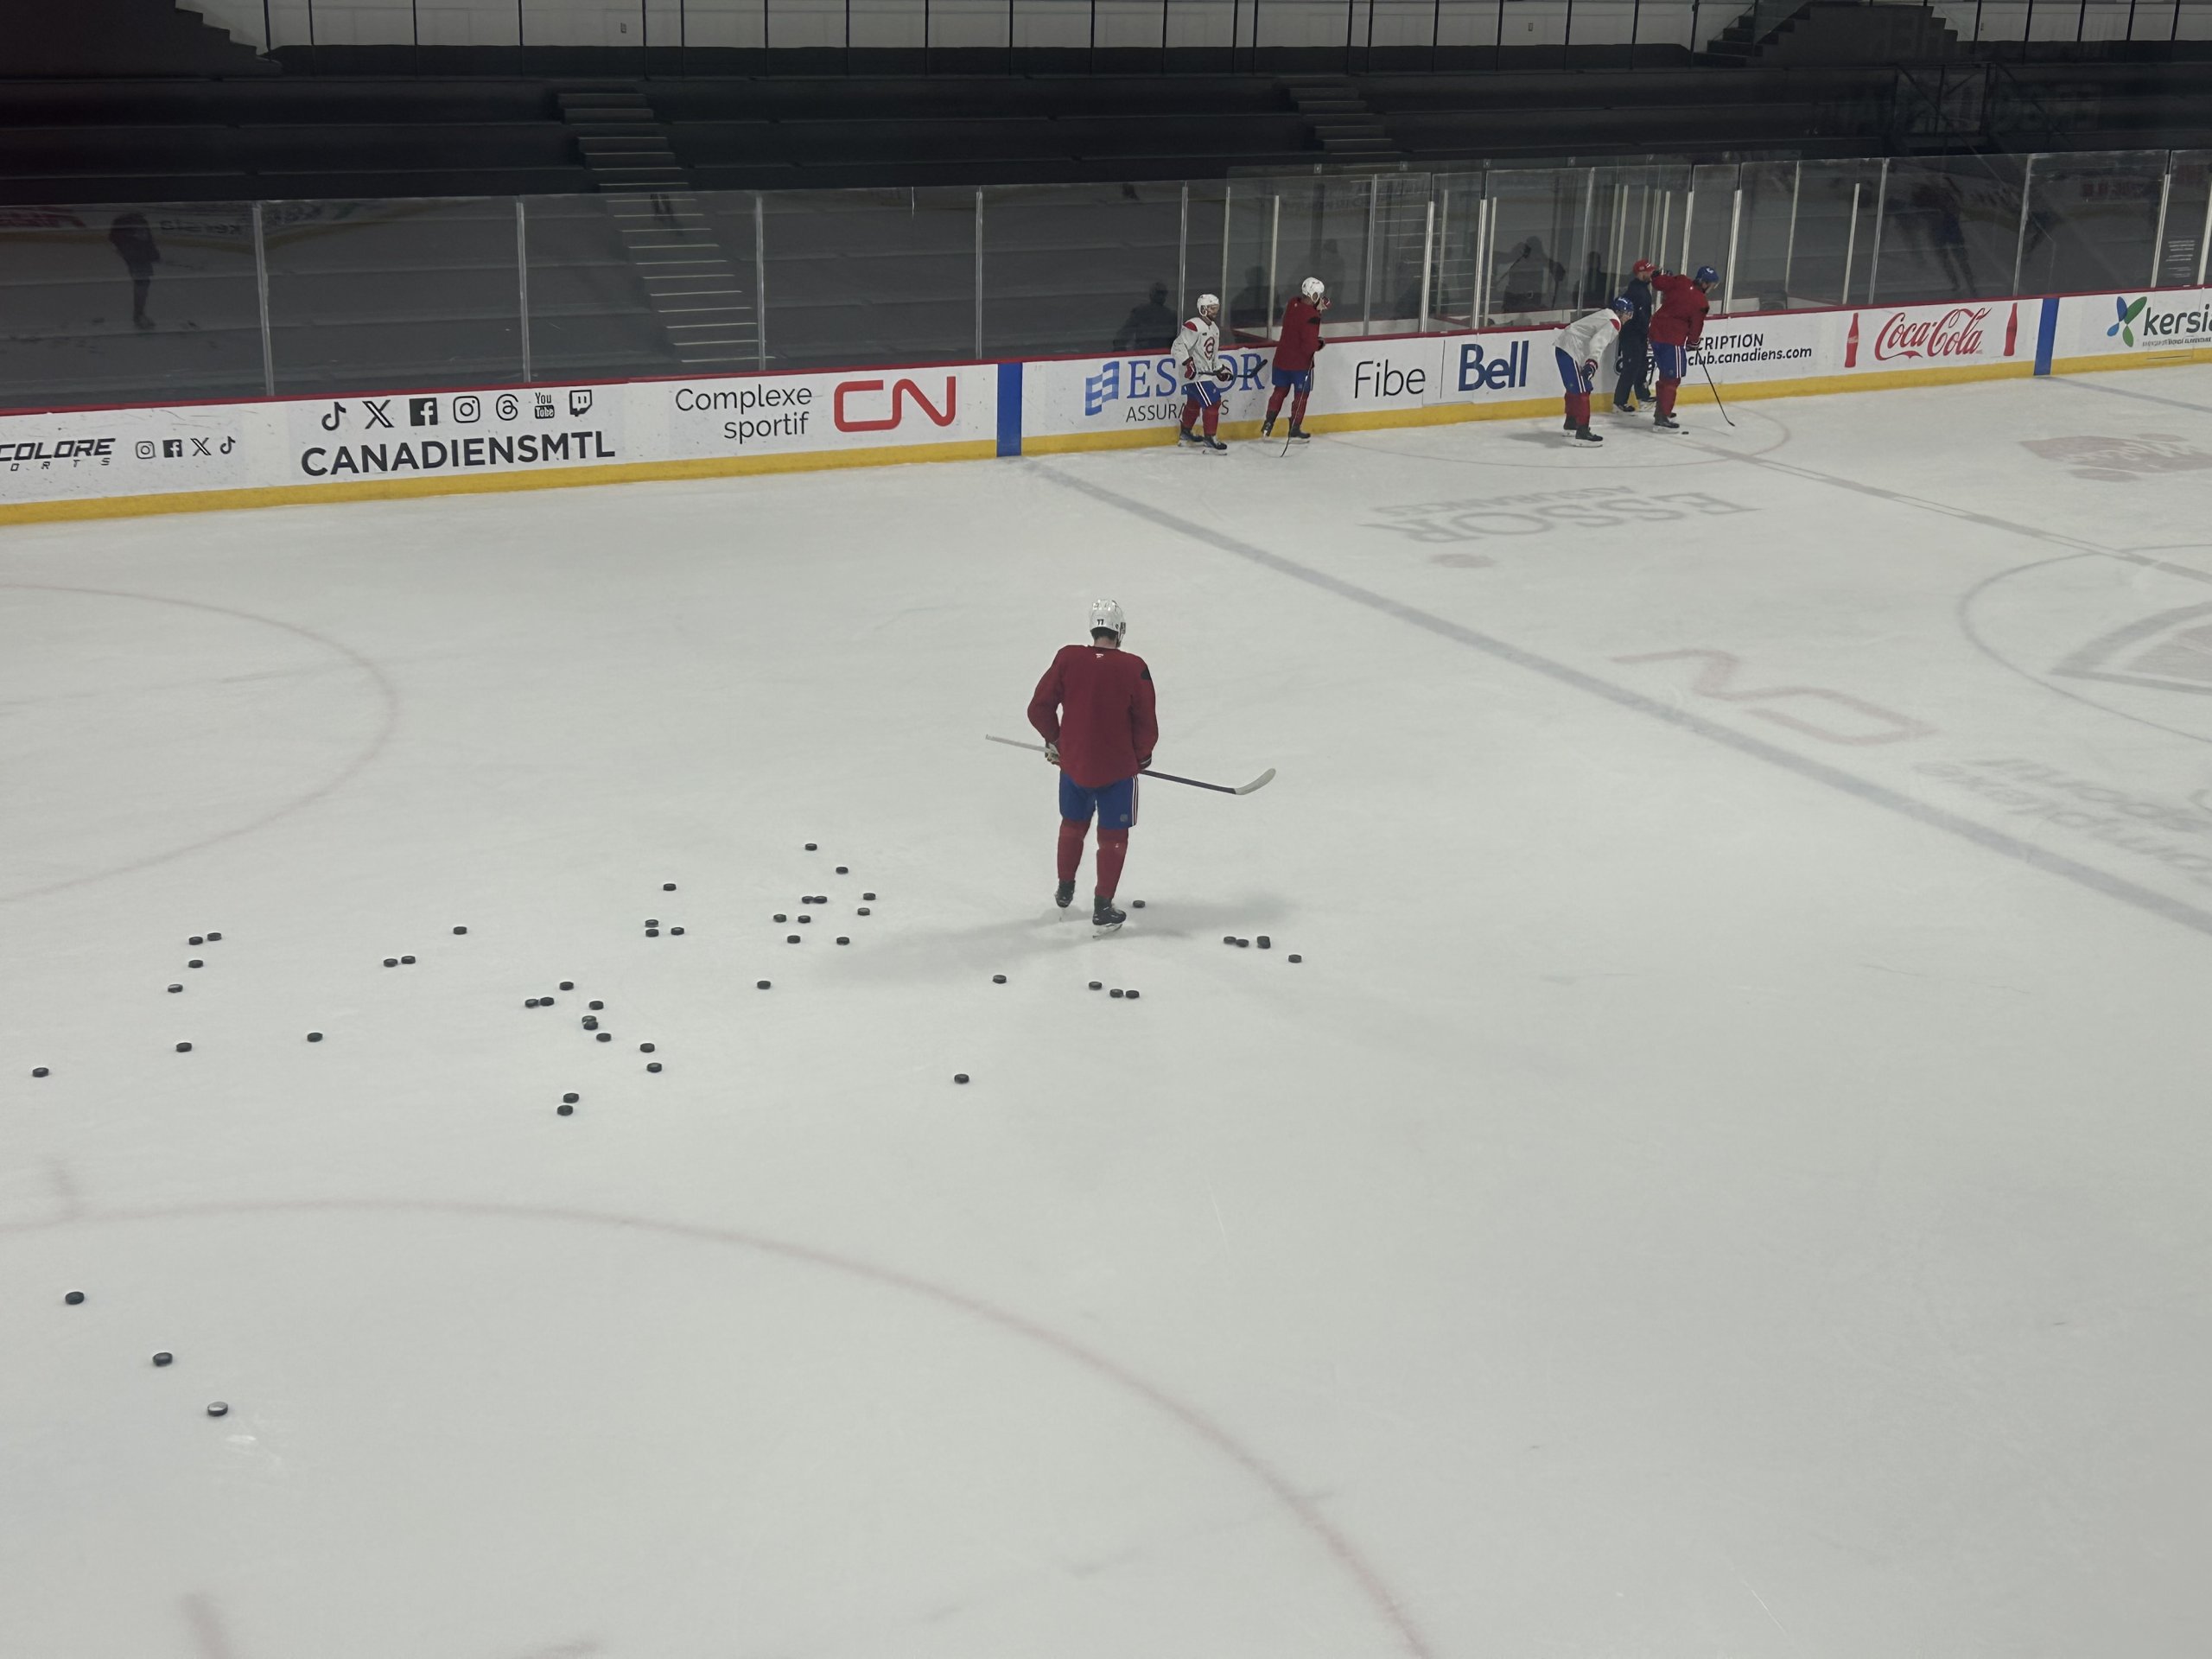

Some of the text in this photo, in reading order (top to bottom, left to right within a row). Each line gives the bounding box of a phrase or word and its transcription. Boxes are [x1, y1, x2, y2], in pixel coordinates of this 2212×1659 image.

[1874, 308, 1992, 360] Coca-Cola
[2143, 303, 2212, 336] kersi
[1126, 353, 1265, 399] ESOR
[1354, 359, 1426, 398] Fibe
[1458, 340, 1529, 392] Bell
[535, 391, 552, 404] You
[675, 384, 813, 415] Complexe
[833, 375, 956, 433] CN
[723, 411, 810, 444] sportif
[0, 437, 117, 462] COLORE
[301, 430, 616, 477] CANADIENSMTL
[1356, 492, 1764, 543] ESSOR
